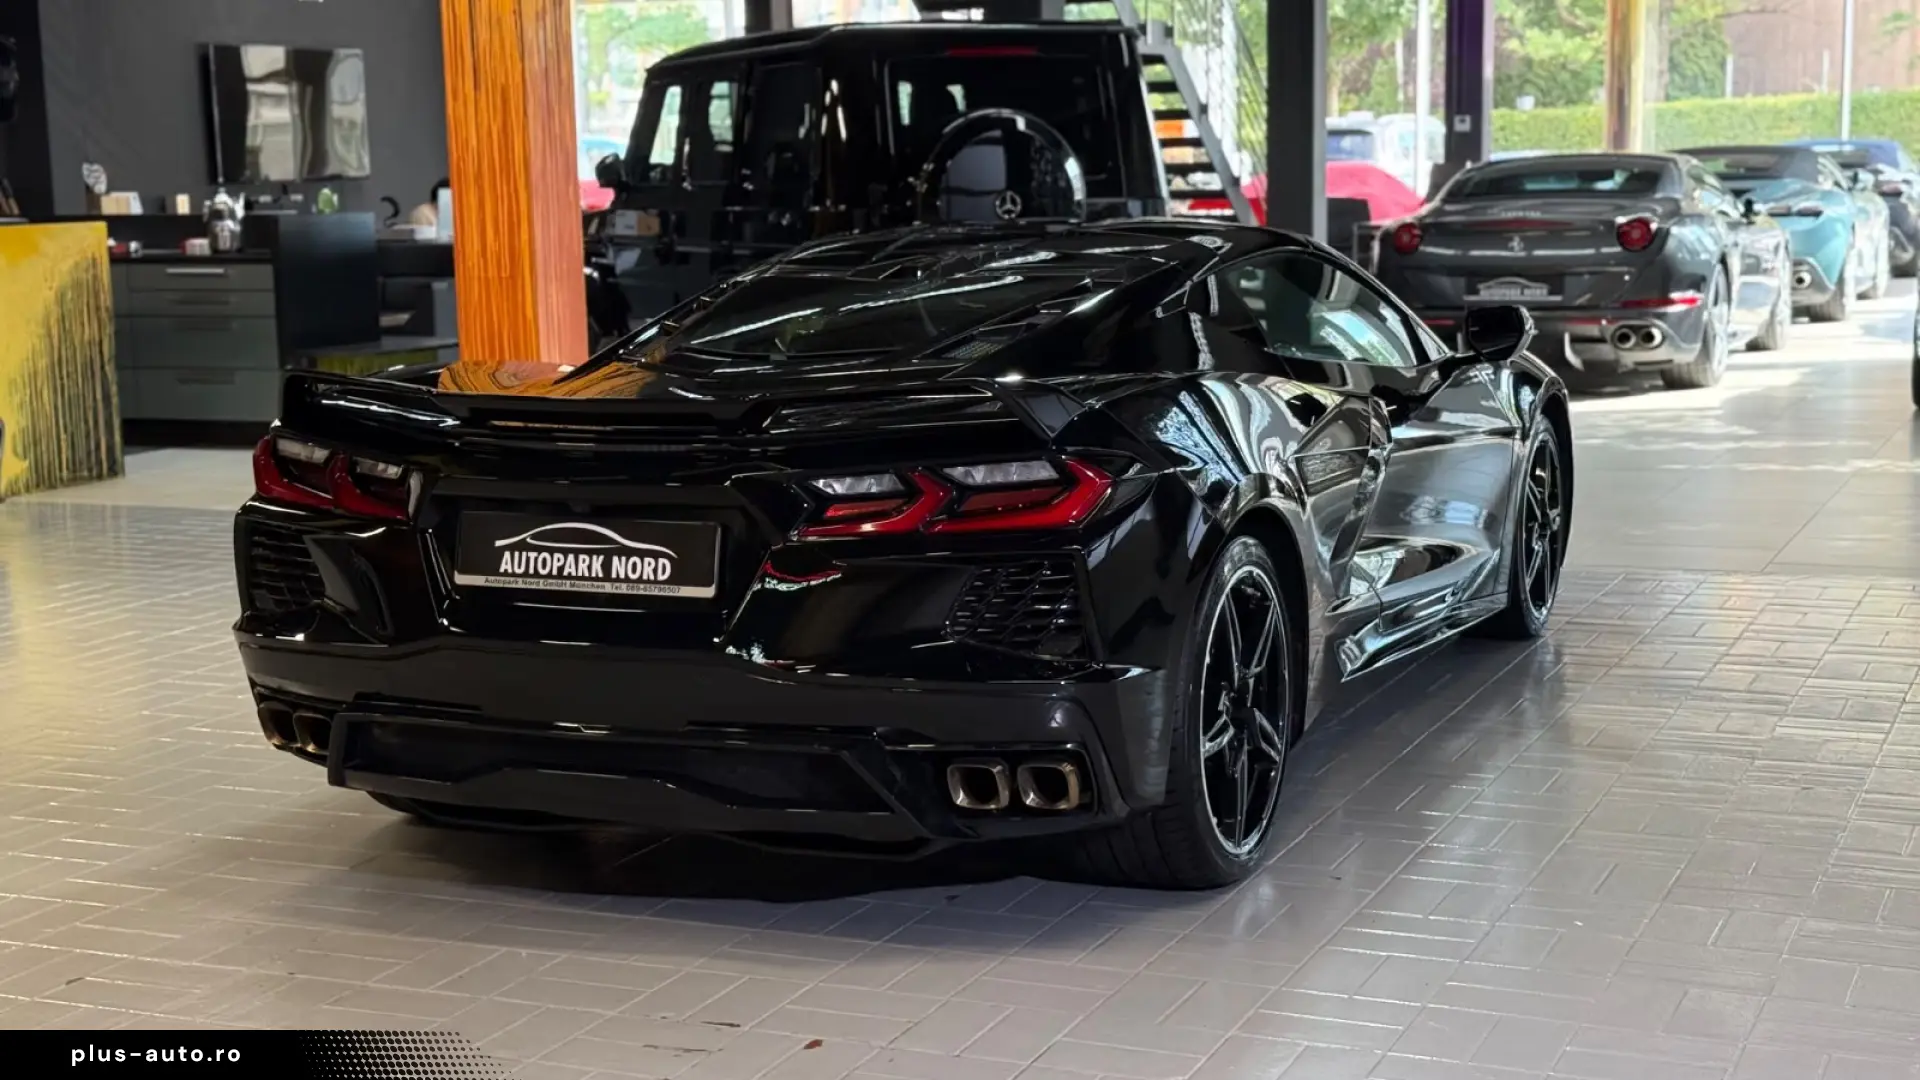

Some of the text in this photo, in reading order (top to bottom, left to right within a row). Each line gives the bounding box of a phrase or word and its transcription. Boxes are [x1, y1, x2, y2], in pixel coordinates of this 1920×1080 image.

[499, 550, 672, 581] AUTOPARK NORD
[484, 577, 519, 587] Autopark
[521, 579, 540, 587] Nord
